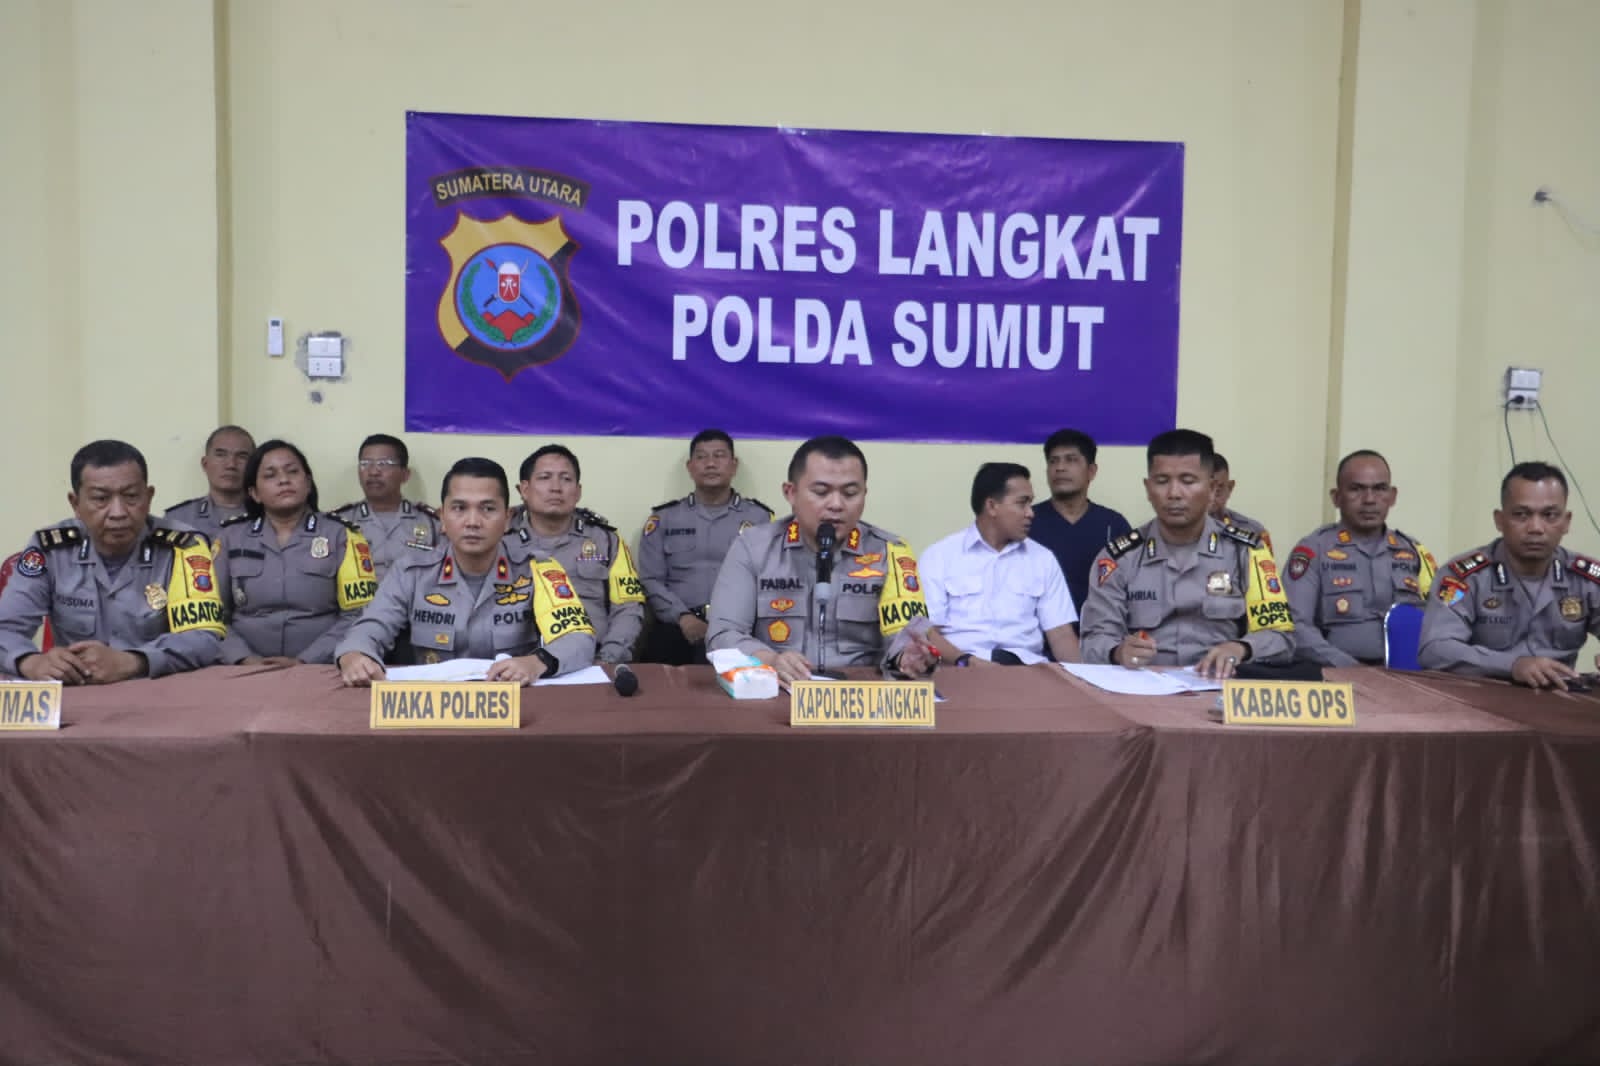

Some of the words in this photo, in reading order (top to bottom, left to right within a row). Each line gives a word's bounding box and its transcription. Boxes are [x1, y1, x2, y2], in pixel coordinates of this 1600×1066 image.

[436, 173, 525, 200] SUMATERA
[529, 175, 581, 207] UTARA
[616, 199, 857, 275] POLRES
[878, 208, 1160, 282] LANGKAT
[672, 294, 873, 366] POLDA
[890, 300, 1105, 371] SUMUT
[414, 609, 456, 625] HENDRI
[550, 616, 581, 635] OPS
[0, 690, 51, 723] MAS
[381, 690, 435, 719] WAKA
[439, 690, 510, 720] POLRES
[797, 687, 865, 719] KAPOLRES
[868, 687, 928, 719] LANGKAT
[1231, 687, 1301, 718] KABAG
[1307, 688, 1348, 719] OPS
